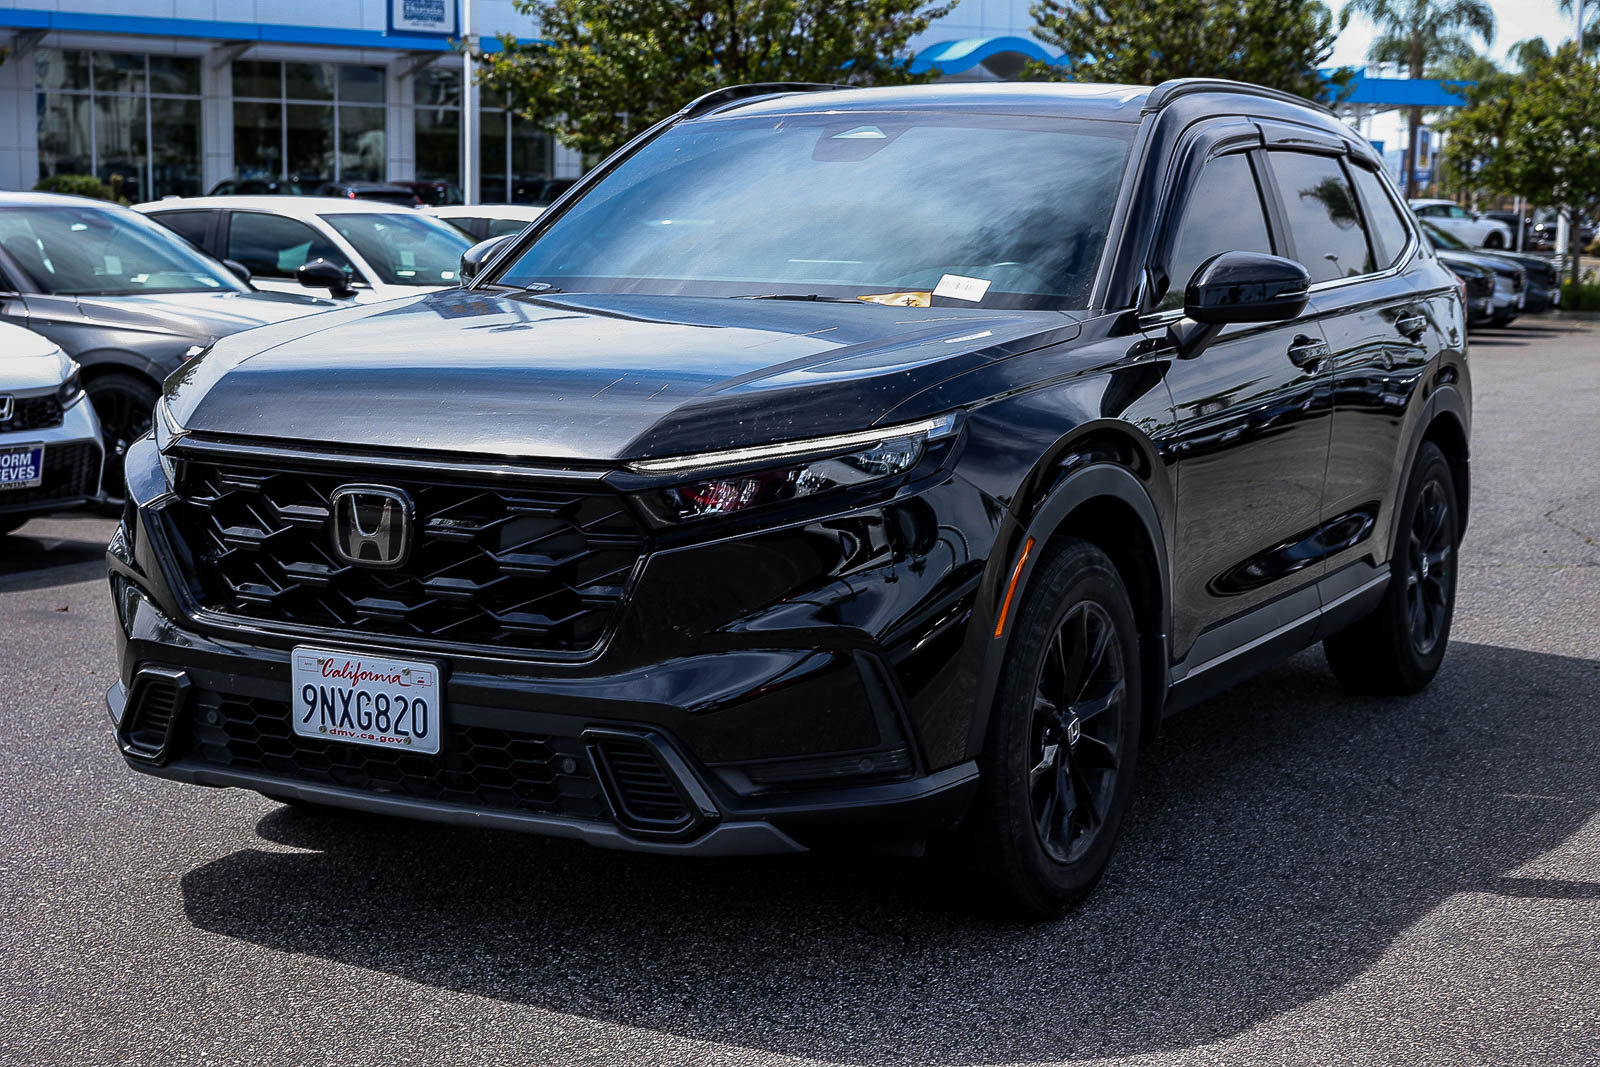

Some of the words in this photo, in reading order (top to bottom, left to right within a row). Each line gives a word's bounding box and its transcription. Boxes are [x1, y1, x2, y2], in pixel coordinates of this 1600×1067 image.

[0, 453, 32, 468] ORM
[0, 466, 35, 481] EVES
[322, 658, 412, 687] California
[302, 684, 428, 739] 9NXG820
[329, 728, 404, 744] dmv.ca.gov
